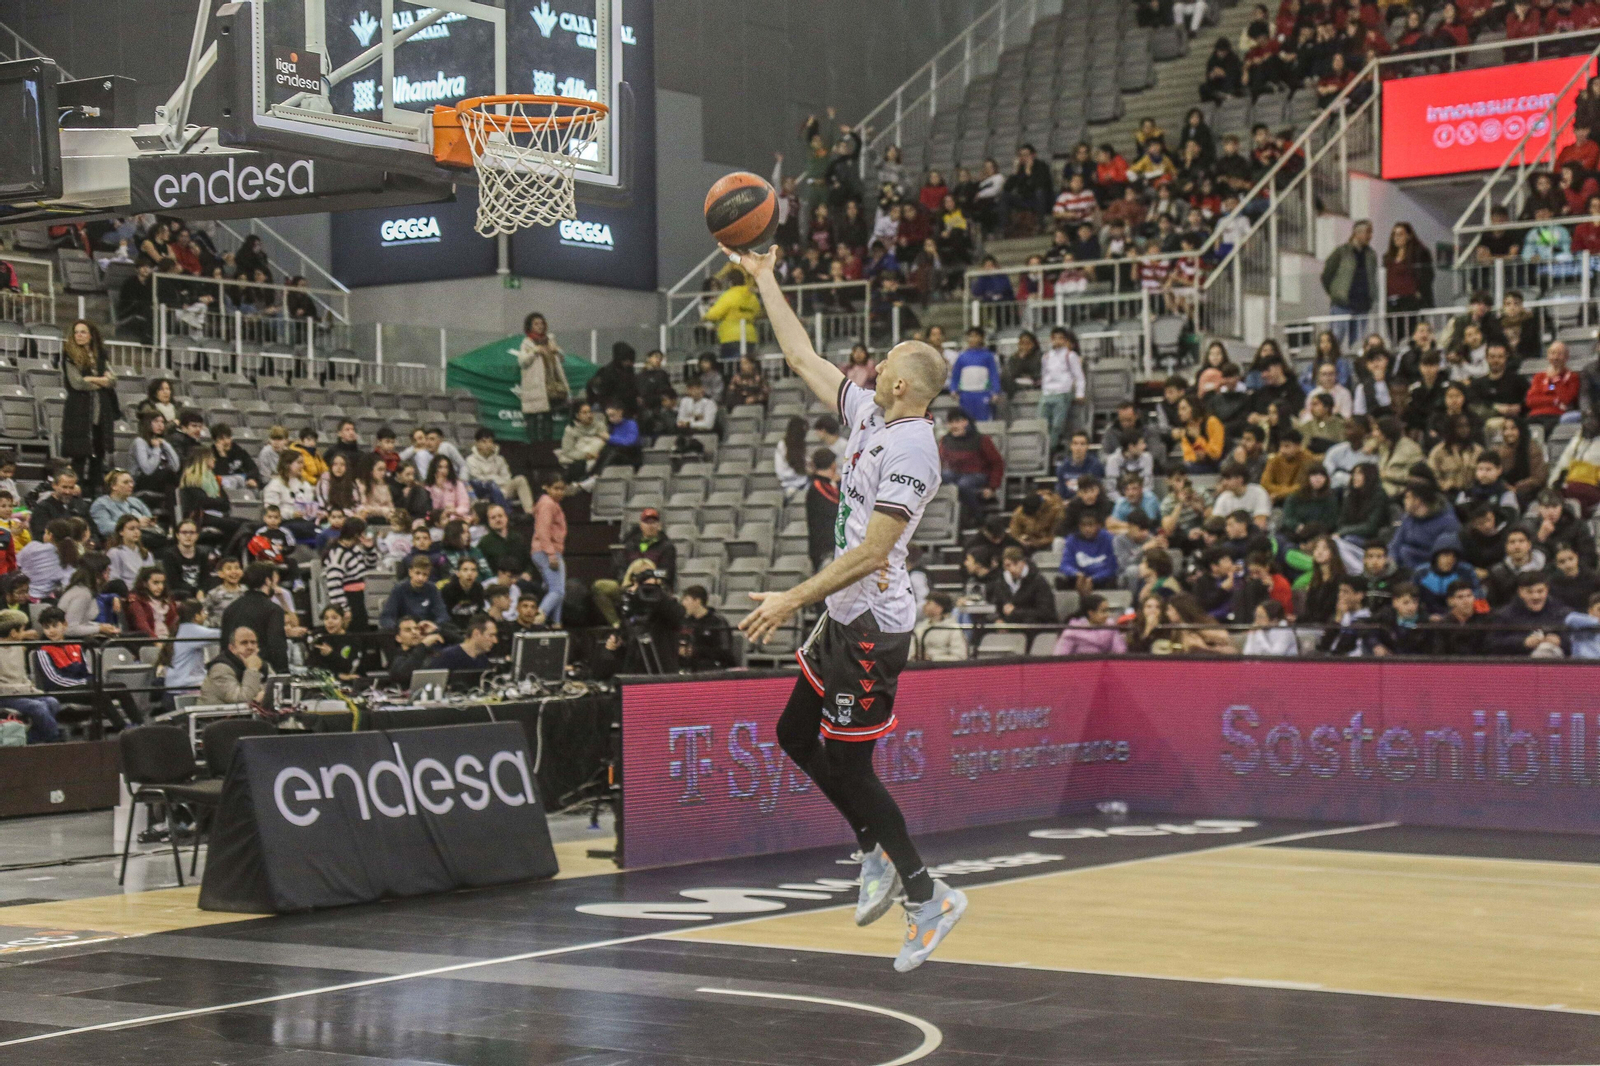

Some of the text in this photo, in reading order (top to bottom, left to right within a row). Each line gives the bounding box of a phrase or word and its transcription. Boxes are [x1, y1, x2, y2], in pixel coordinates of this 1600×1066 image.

[275, 58, 297, 74] liga
[275, 73, 320, 91] endesa
[153, 157, 314, 208] endesa
[889, 473, 927, 495] CASTOR
[273, 742, 535, 827] endesa
